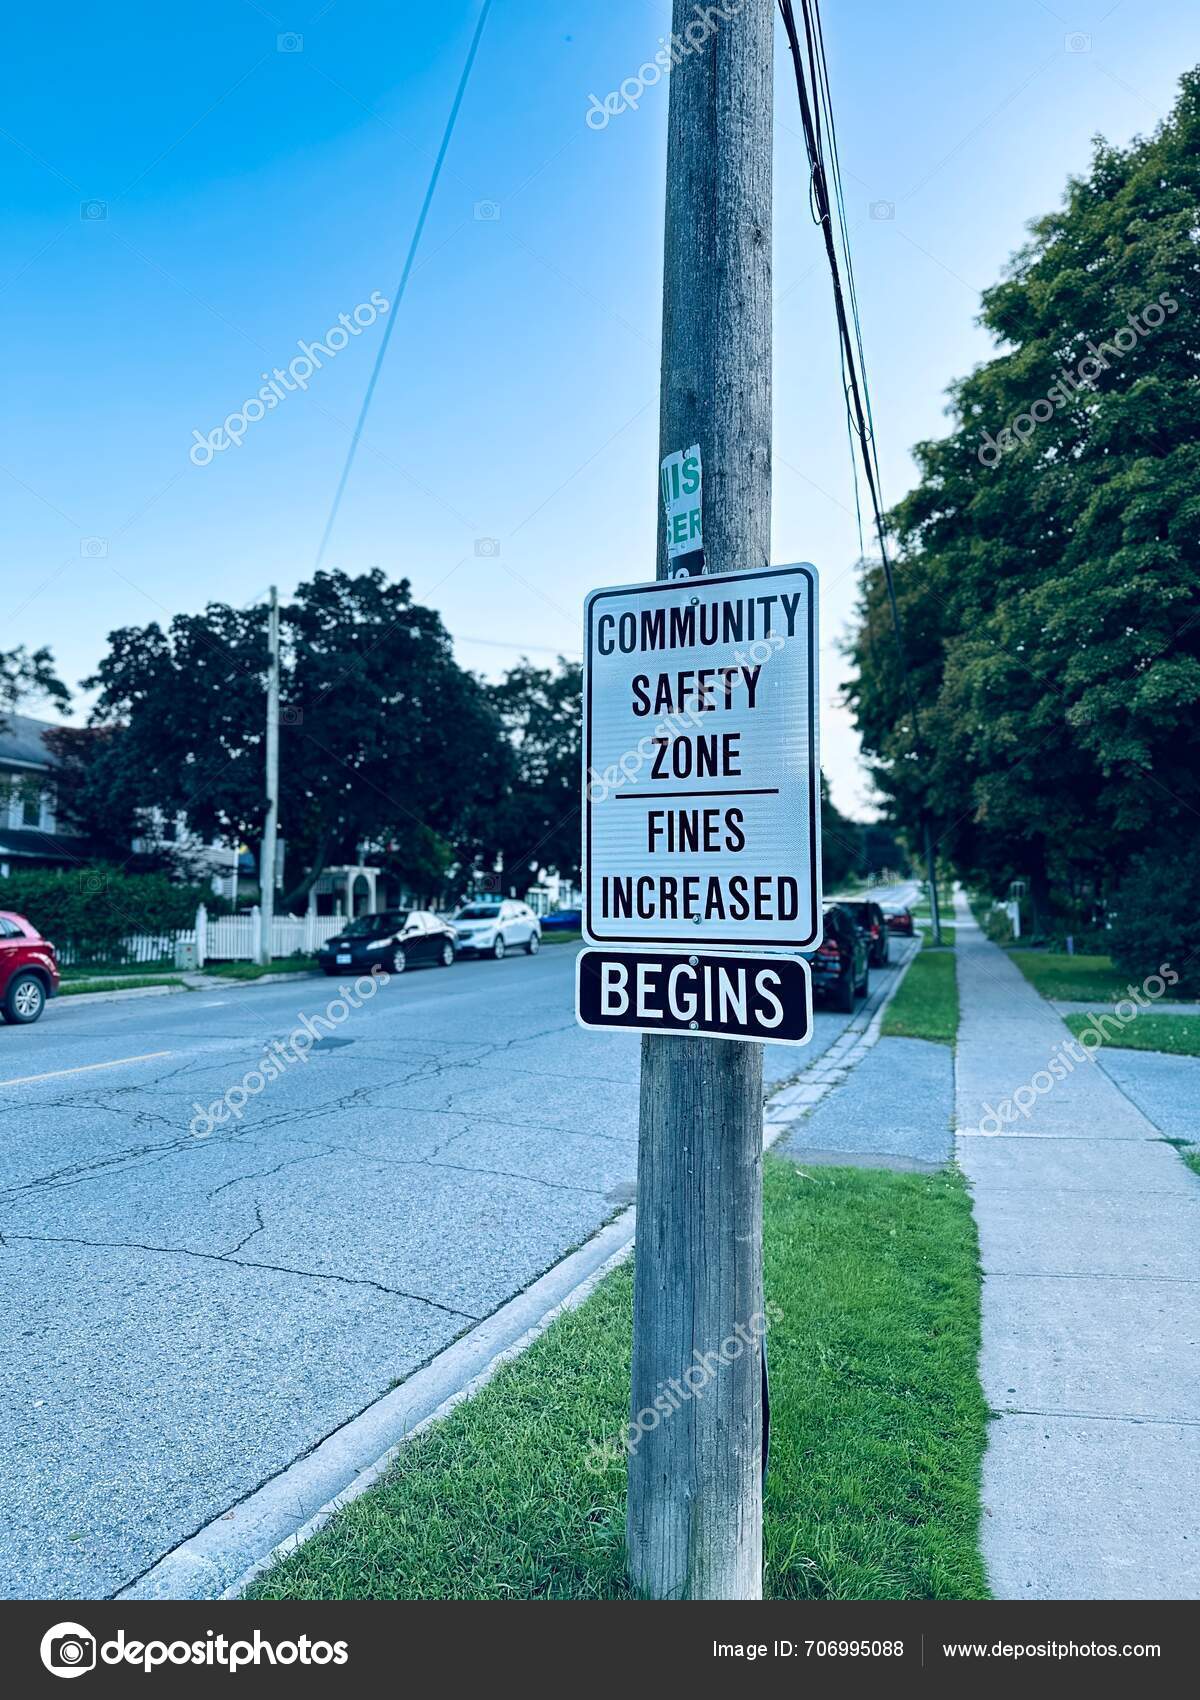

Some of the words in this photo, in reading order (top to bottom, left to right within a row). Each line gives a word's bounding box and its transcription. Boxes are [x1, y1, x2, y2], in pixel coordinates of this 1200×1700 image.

[598, 593, 801, 655] COMMUNITY
[632, 665, 761, 716] SAFETY
[651, 733, 742, 780] ZONE
[648, 808, 746, 853] FINES
[602, 876, 799, 921] INCREASED
[601, 962, 784, 1029] BEGINS
